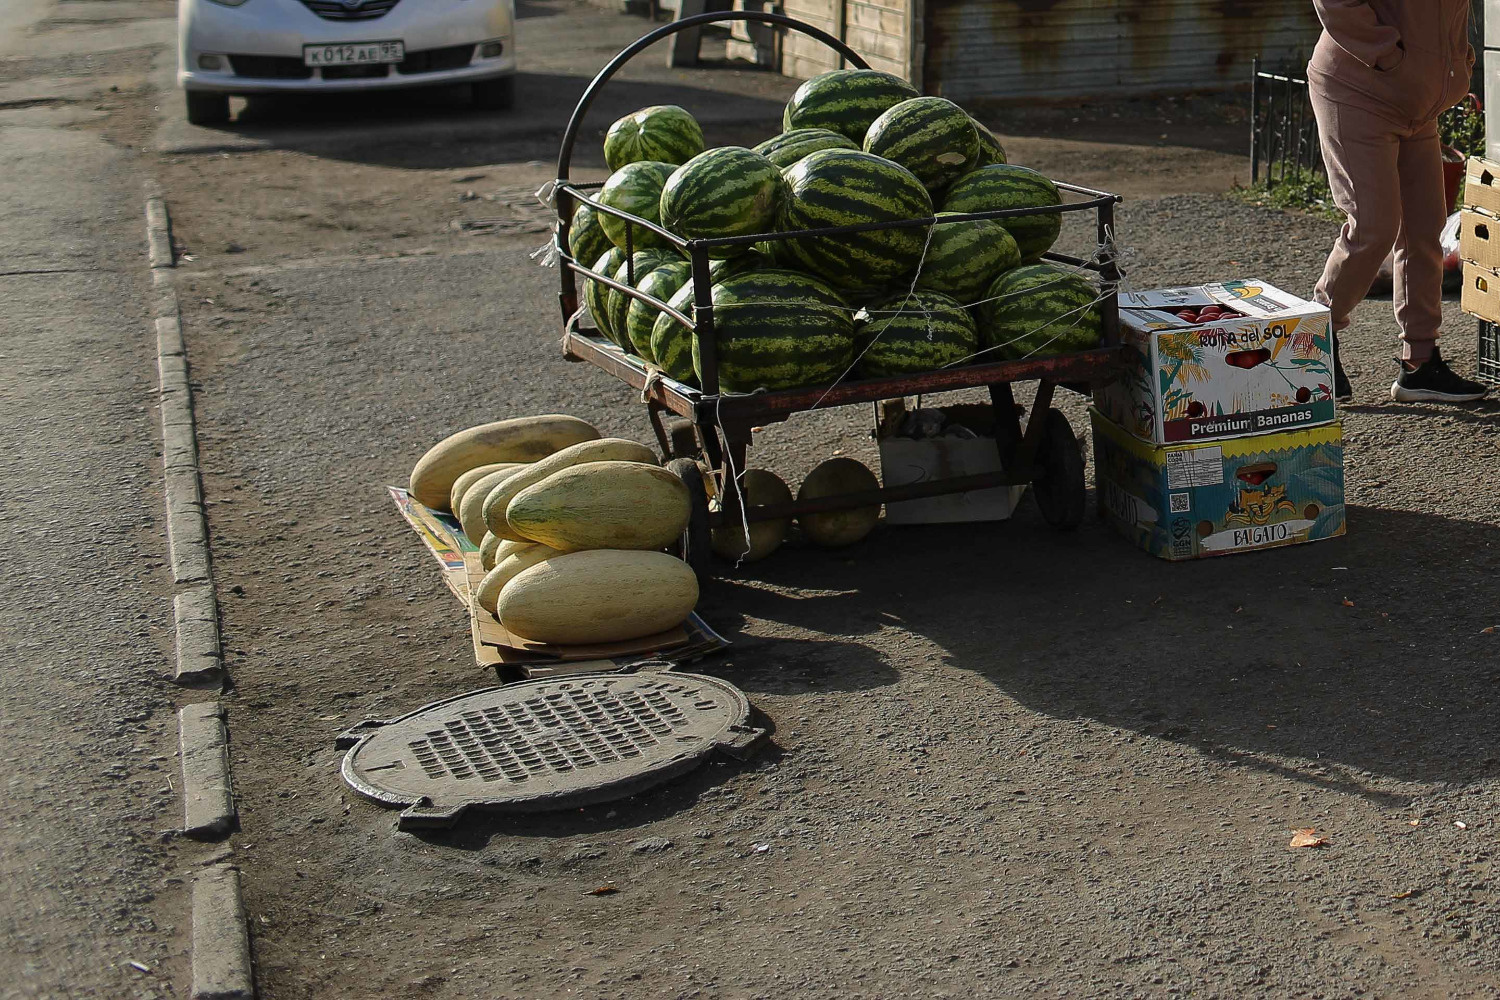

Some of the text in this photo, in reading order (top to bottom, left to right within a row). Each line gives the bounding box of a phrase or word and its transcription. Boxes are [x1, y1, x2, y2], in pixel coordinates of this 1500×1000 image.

[1240, 327, 1260, 343] del
[1263, 324, 1292, 341] SOL
[1191, 409, 1312, 435] Premium Bananas
